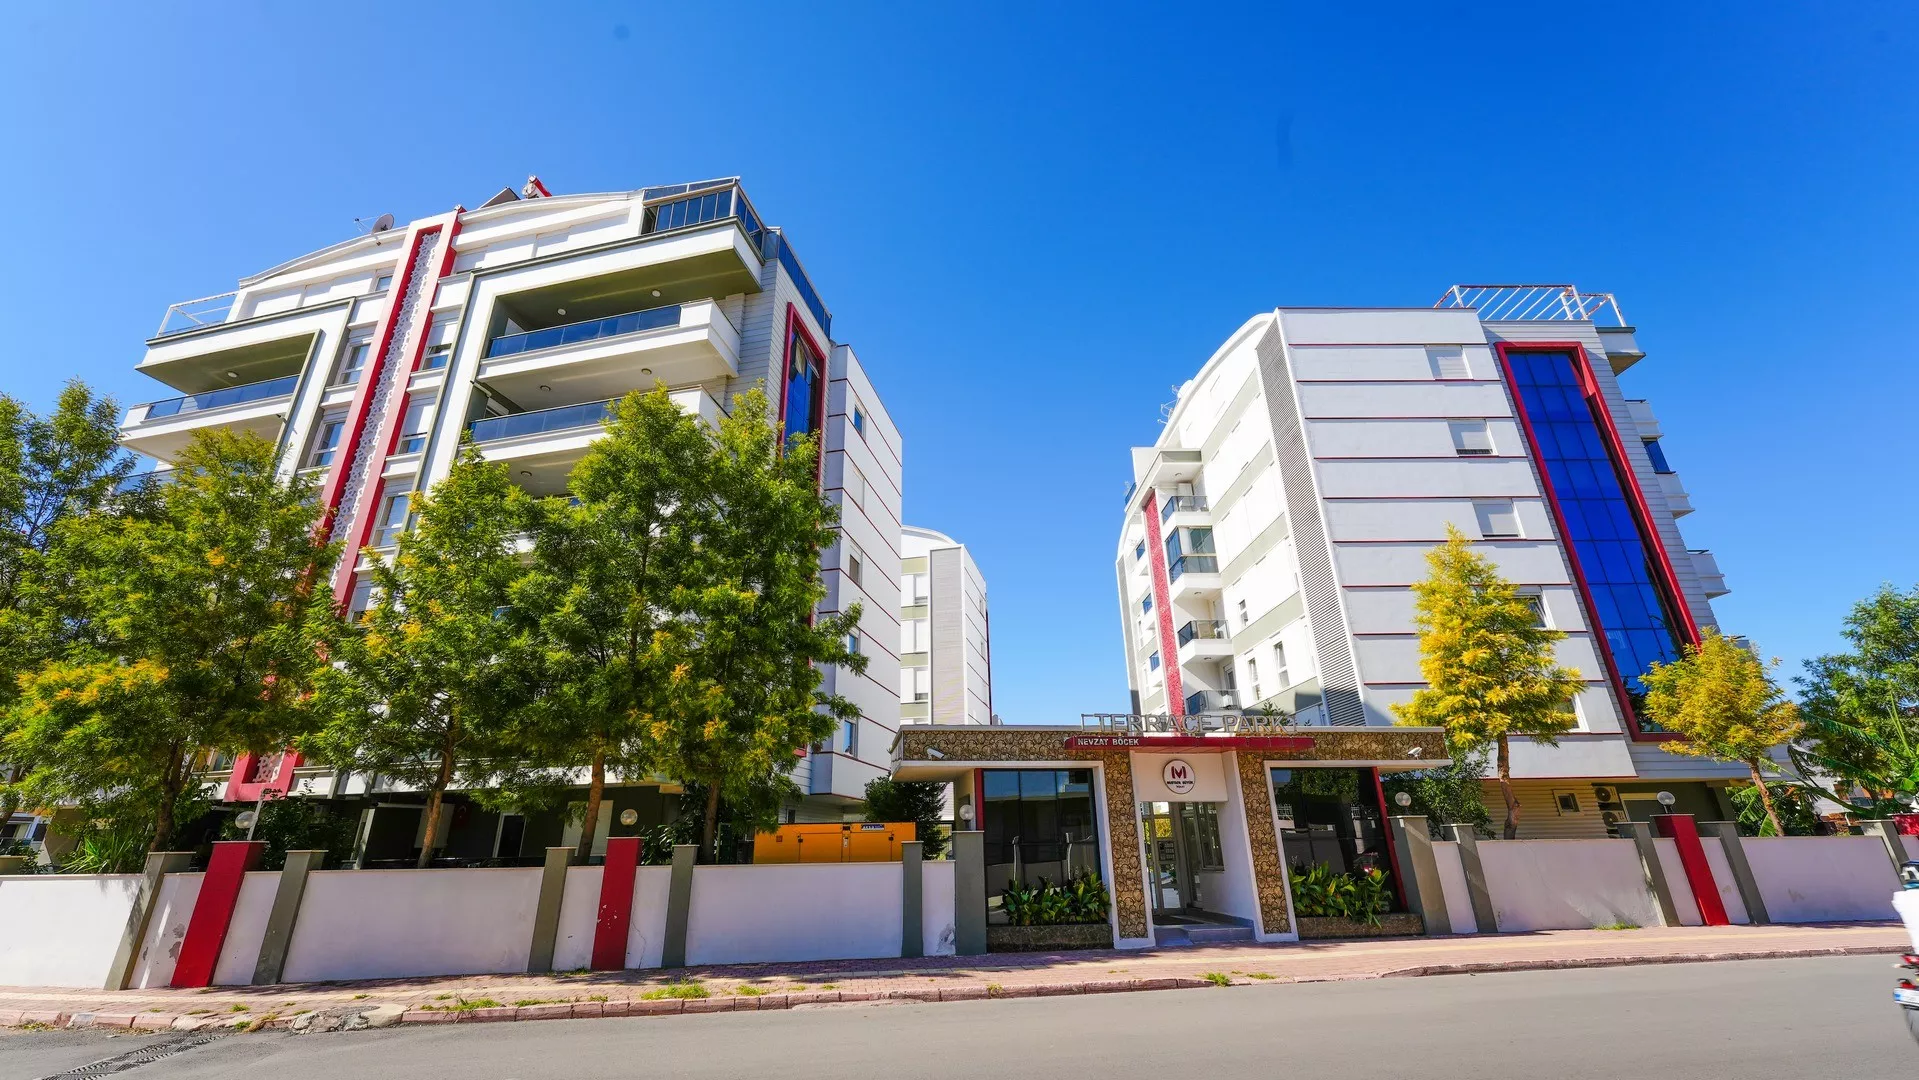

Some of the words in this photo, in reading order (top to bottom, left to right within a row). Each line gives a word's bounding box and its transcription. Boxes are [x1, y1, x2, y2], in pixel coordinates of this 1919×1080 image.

[1094, 714, 1211, 733] TERRACE
[1222, 715, 1288, 734] PARK
[1077, 738, 1108, 746] NEVZAT
[1112, 736, 1139, 746] BÖCEK
[1171, 766, 1186, 779] M
